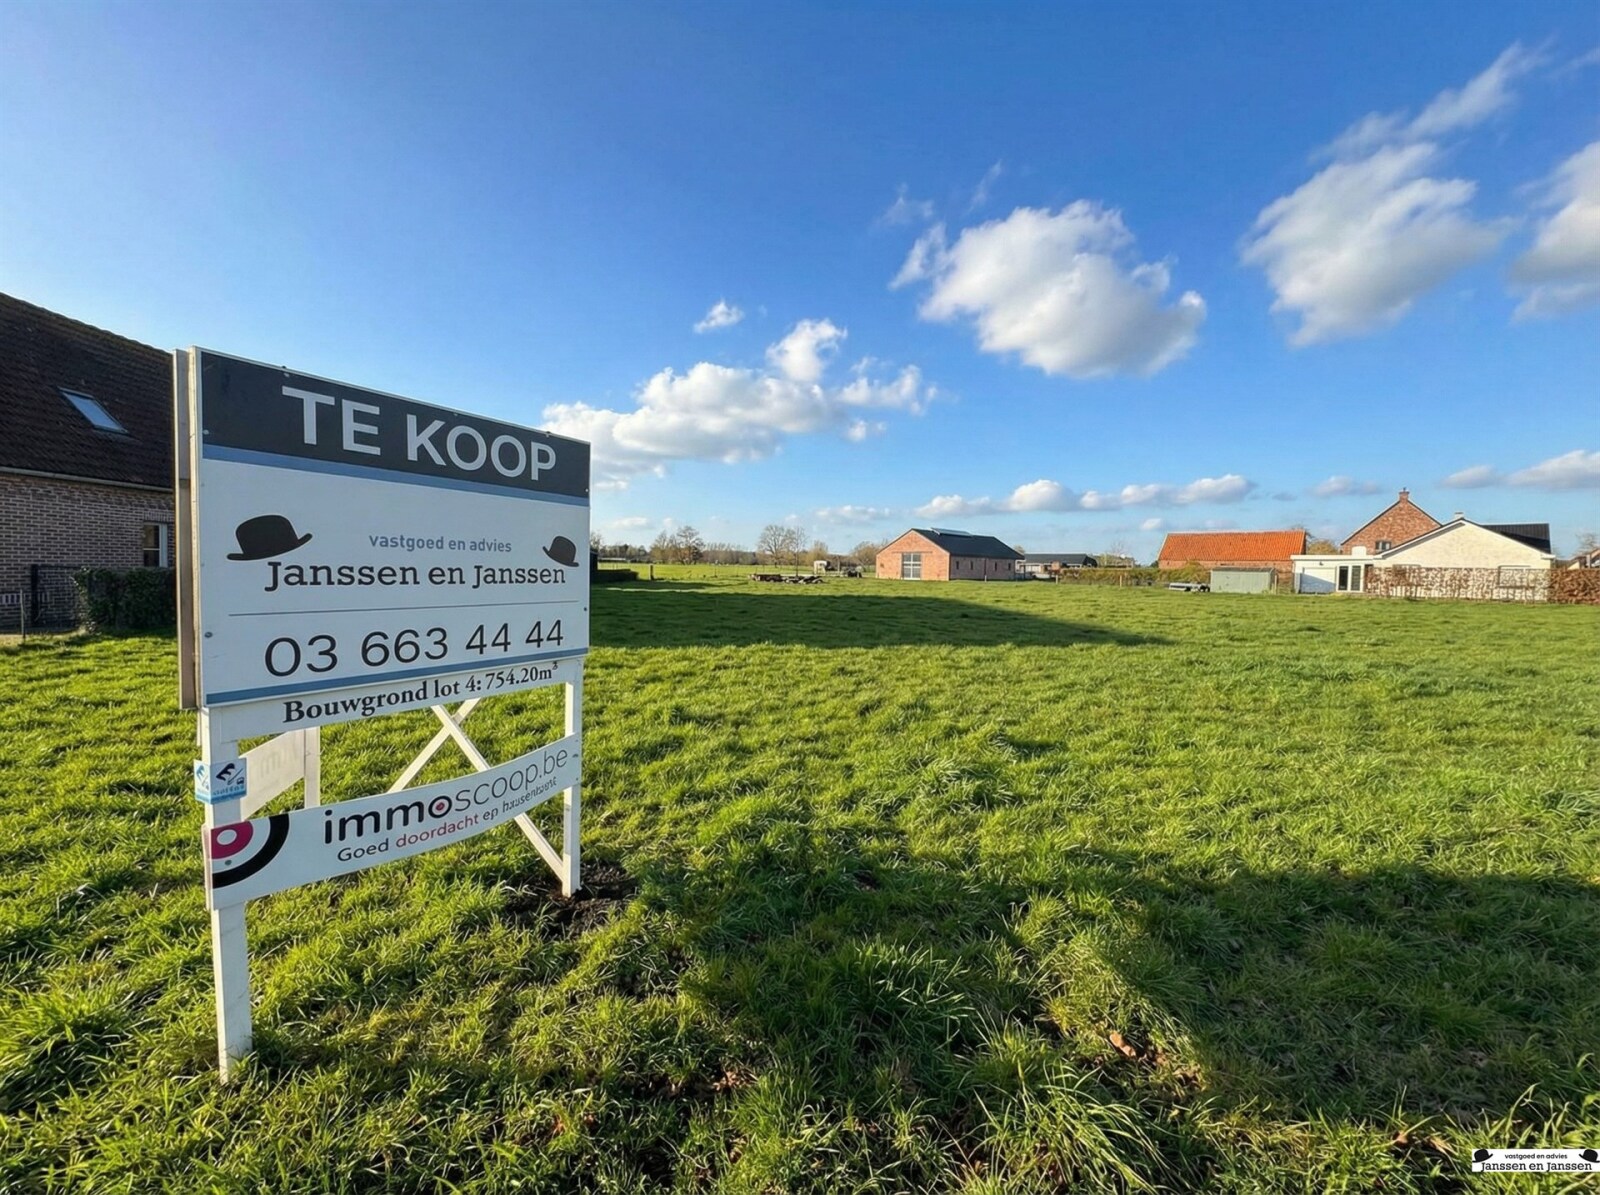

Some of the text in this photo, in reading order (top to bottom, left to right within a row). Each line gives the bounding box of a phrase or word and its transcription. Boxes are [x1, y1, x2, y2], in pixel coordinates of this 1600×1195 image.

[282, 386, 556, 481] TE KOOP
[369, 534, 512, 553] vastgoed en advies
[264, 561, 566, 592] Janssen en Janssen
[265, 619, 564, 677] 03 663 44 44
[283, 682, 427, 723] Bouwgrond
[434, 678, 460, 698] lot
[465, 675, 482, 692] 4:
[324, 749, 568, 845] immoscoop.be
[337, 838, 389, 862] Goed
[395, 814, 479, 849] doordacht
